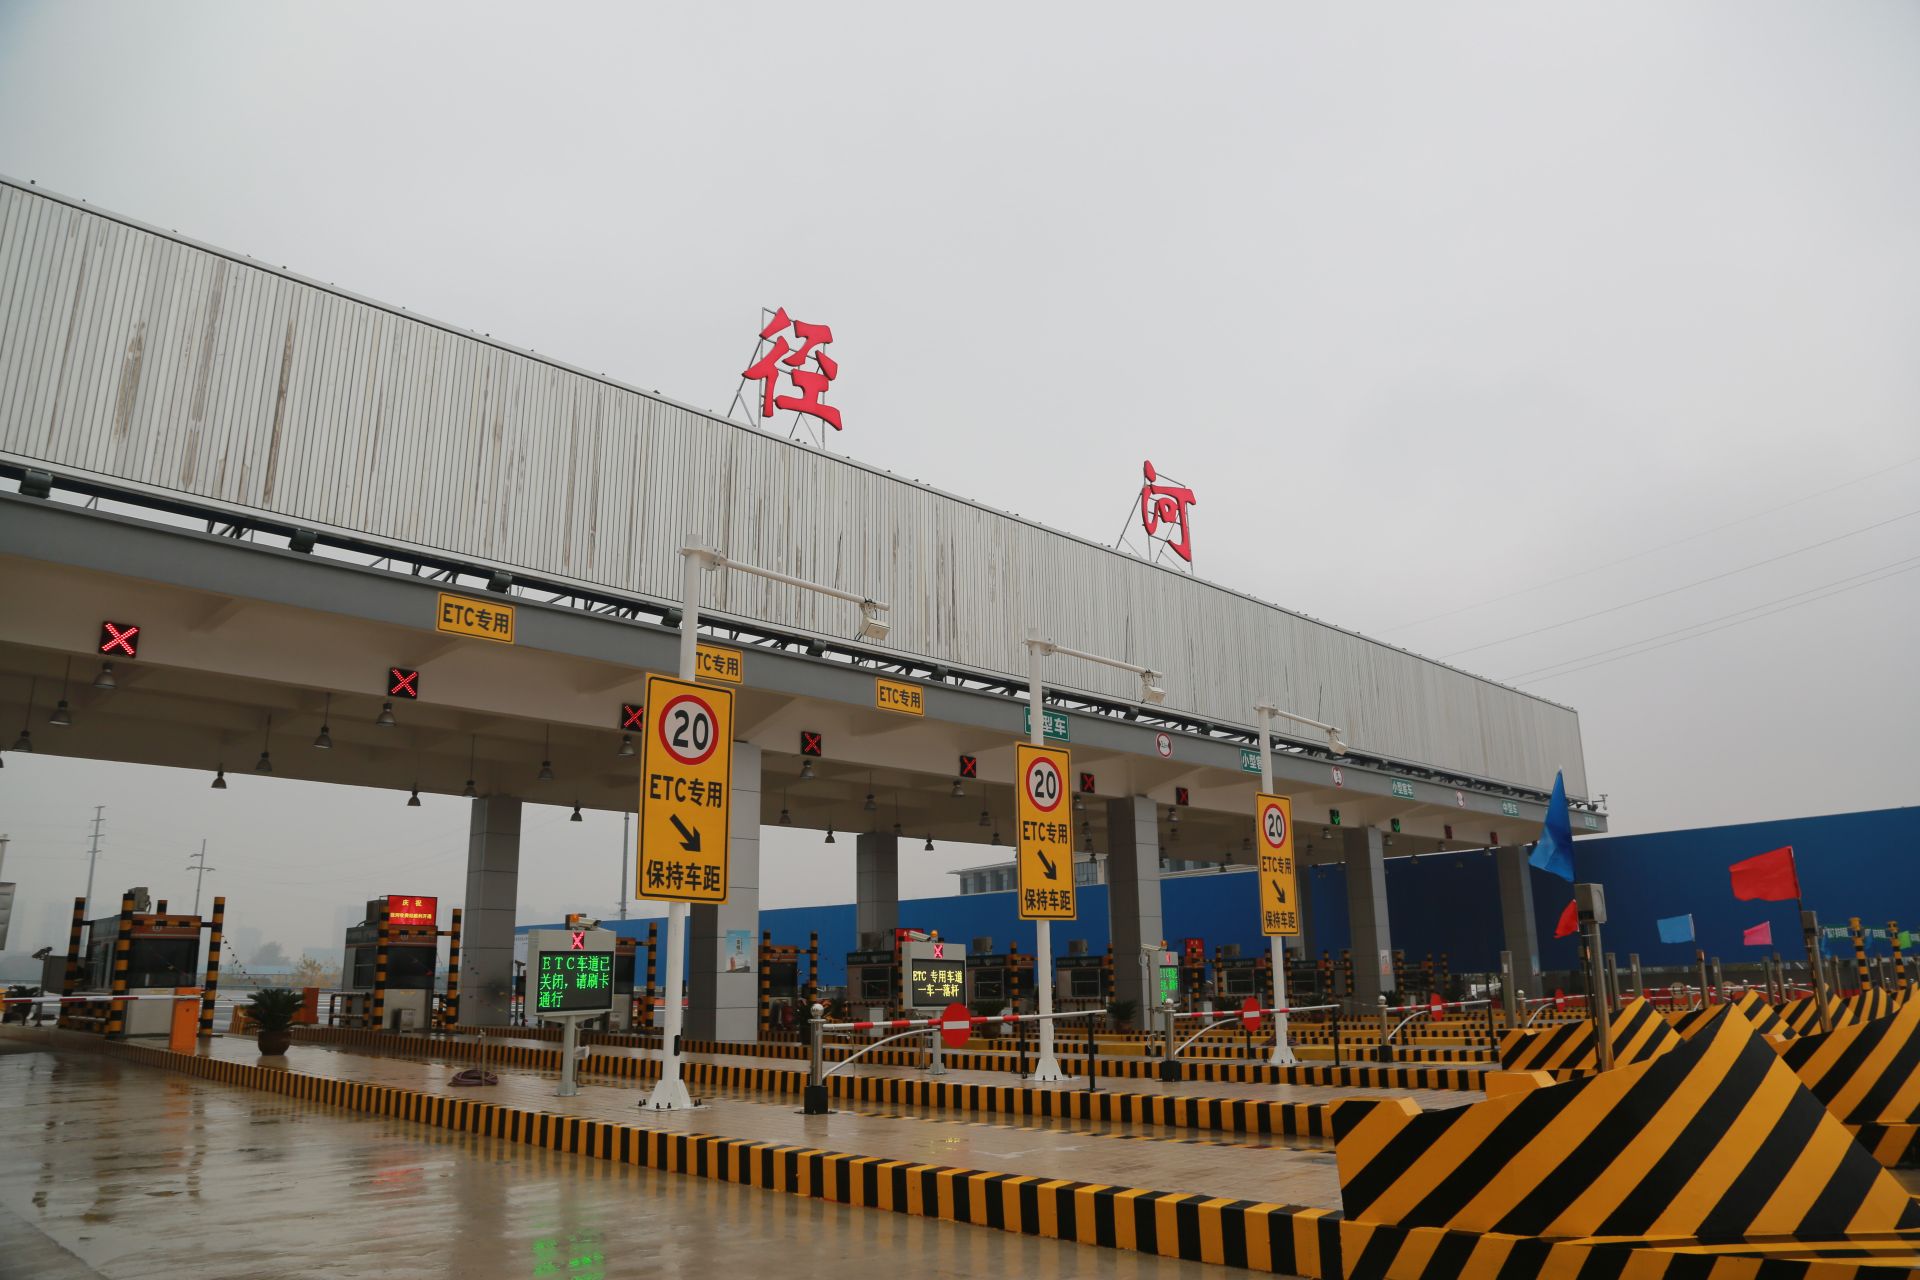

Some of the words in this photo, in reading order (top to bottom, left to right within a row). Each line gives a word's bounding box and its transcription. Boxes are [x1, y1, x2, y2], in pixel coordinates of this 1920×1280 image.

[741, 307, 843, 431] 径
[1141, 460, 1197, 562] 河
[443, 602, 510, 634] ETC专用
[696, 651, 739, 677] TC专用
[879, 685, 921, 709] ETC专用
[672, 709, 709, 750] 20
[1028, 714, 1067, 736] 型车
[649, 773, 723, 809] ETC专用
[1034, 769, 1057, 799] 20
[1022, 820, 1068, 844] ETC专用
[1267, 813, 1283, 838] 20
[646, 859, 721, 892] 保持车距
[1261, 855, 1292, 875] ETC专用
[1024, 887, 1072, 911] 保持车距
[1265, 911, 1296, 929] 保持车距
[912, 970, 927, 981] ETC
[930, 969, 963, 984] 专用车道
[539, 991, 564, 1008] 通行
